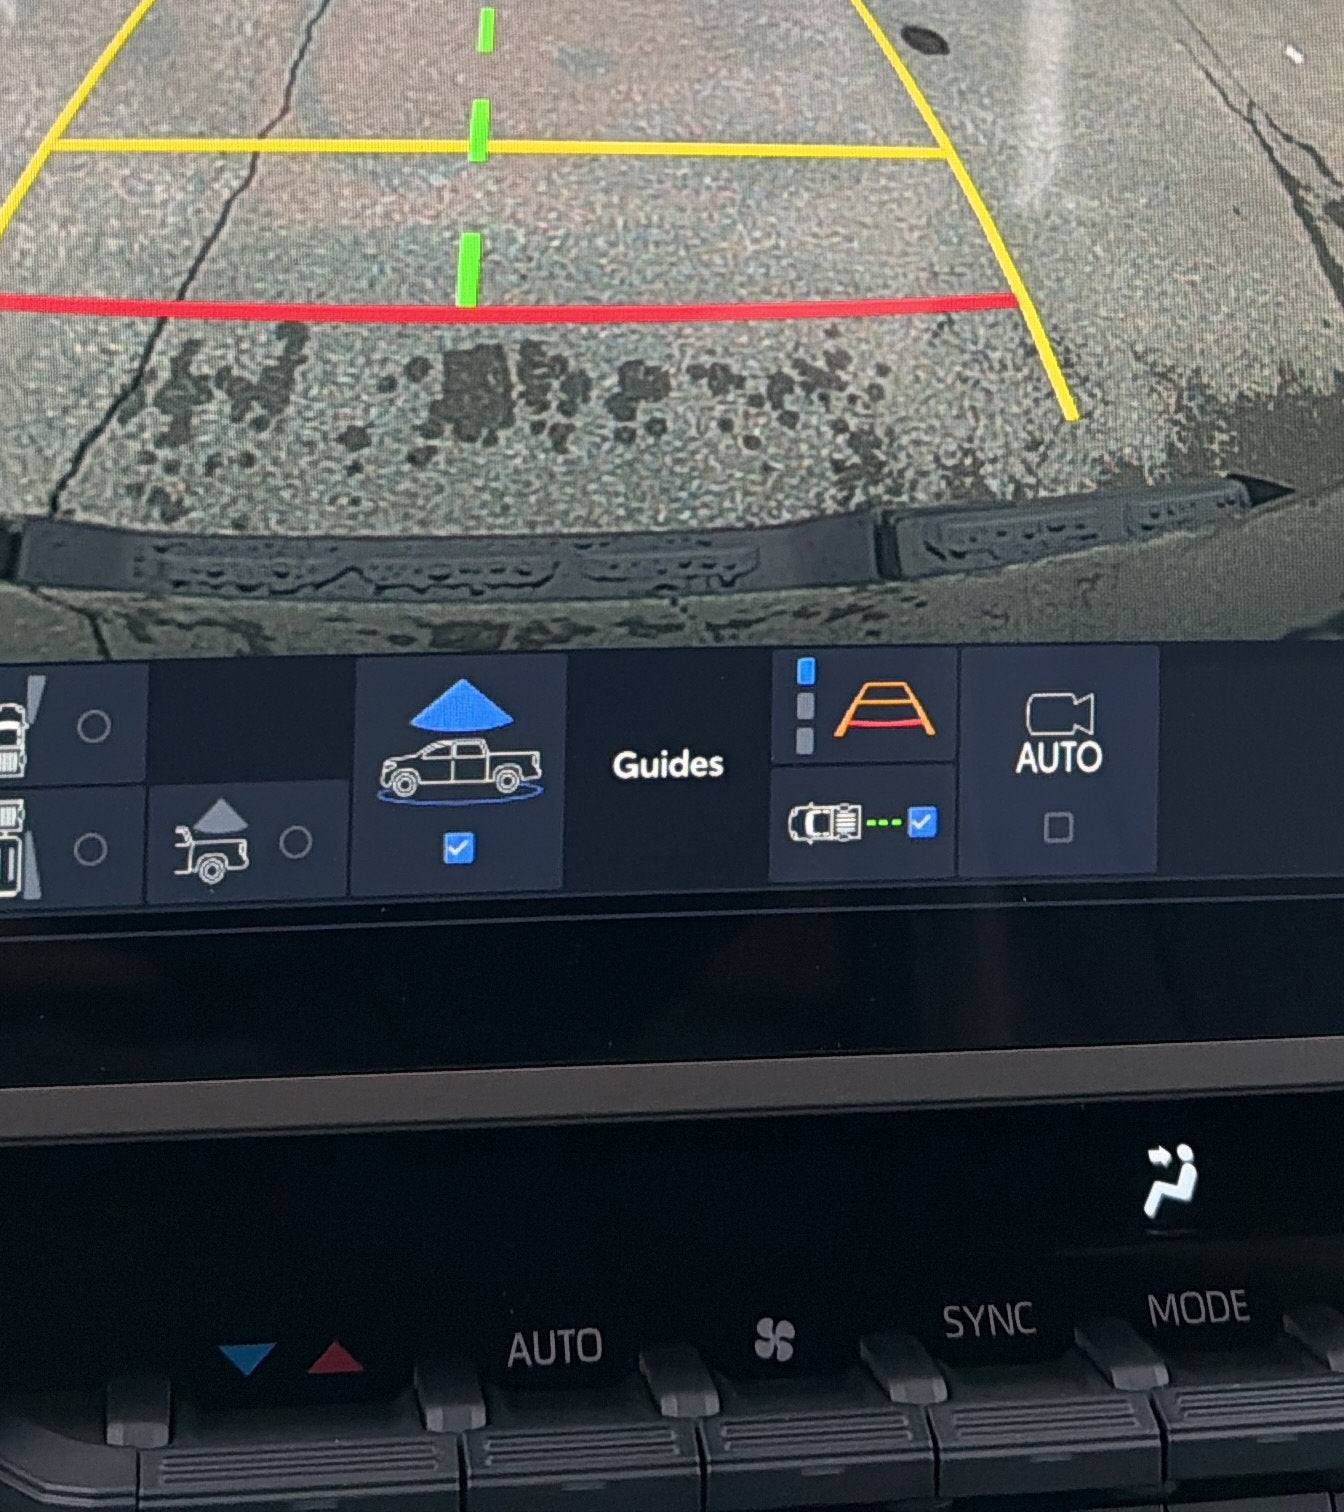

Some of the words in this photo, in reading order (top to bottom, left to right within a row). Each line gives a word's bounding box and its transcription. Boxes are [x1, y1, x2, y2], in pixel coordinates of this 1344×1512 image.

[612, 748, 726, 781] Guides
[1014, 739, 1104, 776] AUTO
[942, 1301, 1037, 1340] SYNC
[1147, 1289, 1251, 1326] MODE
[507, 1327, 604, 1369] AUTO
